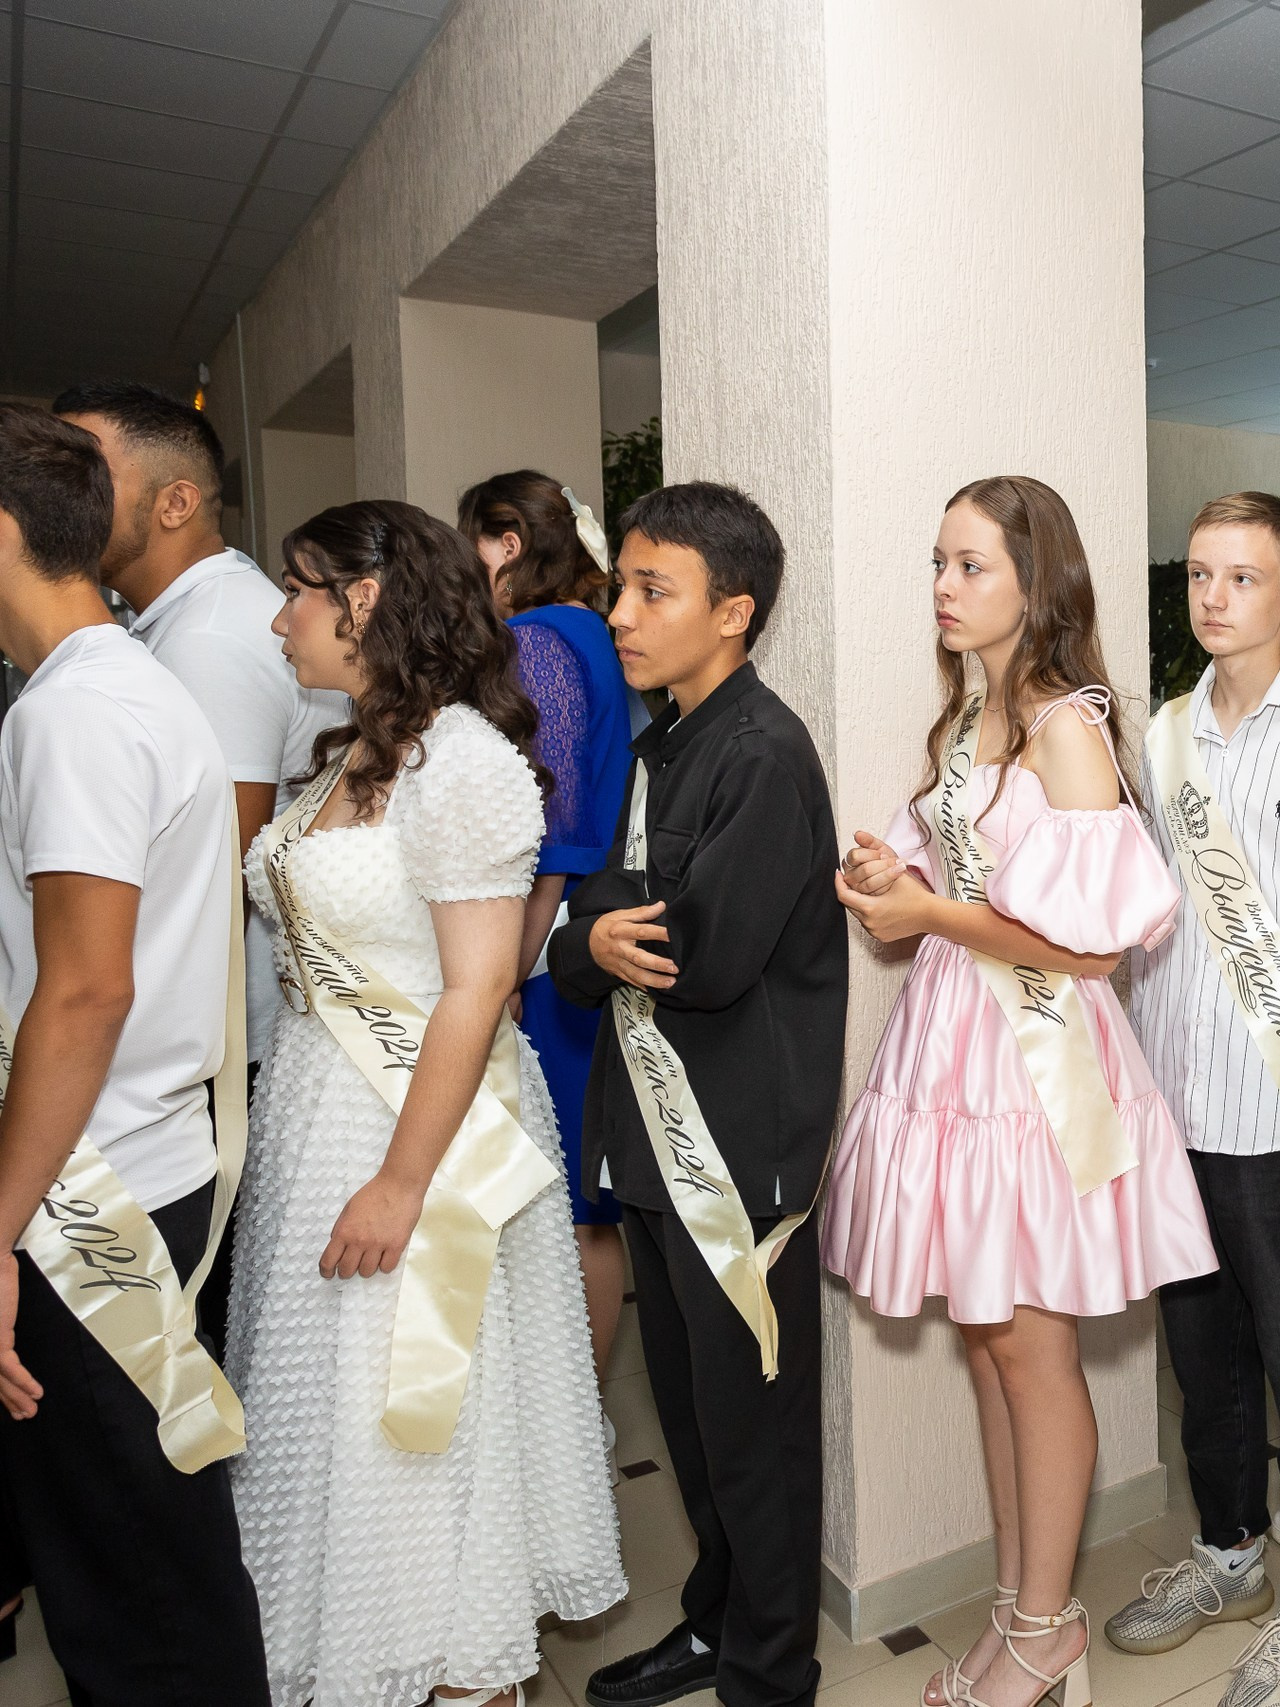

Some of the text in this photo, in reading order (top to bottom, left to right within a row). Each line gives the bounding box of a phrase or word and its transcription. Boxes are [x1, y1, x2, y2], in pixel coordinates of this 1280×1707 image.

[1013, 964, 1066, 1028] 024
[656, 1098, 724, 1197] 2024
[41, 1199, 162, 1293] 2024
